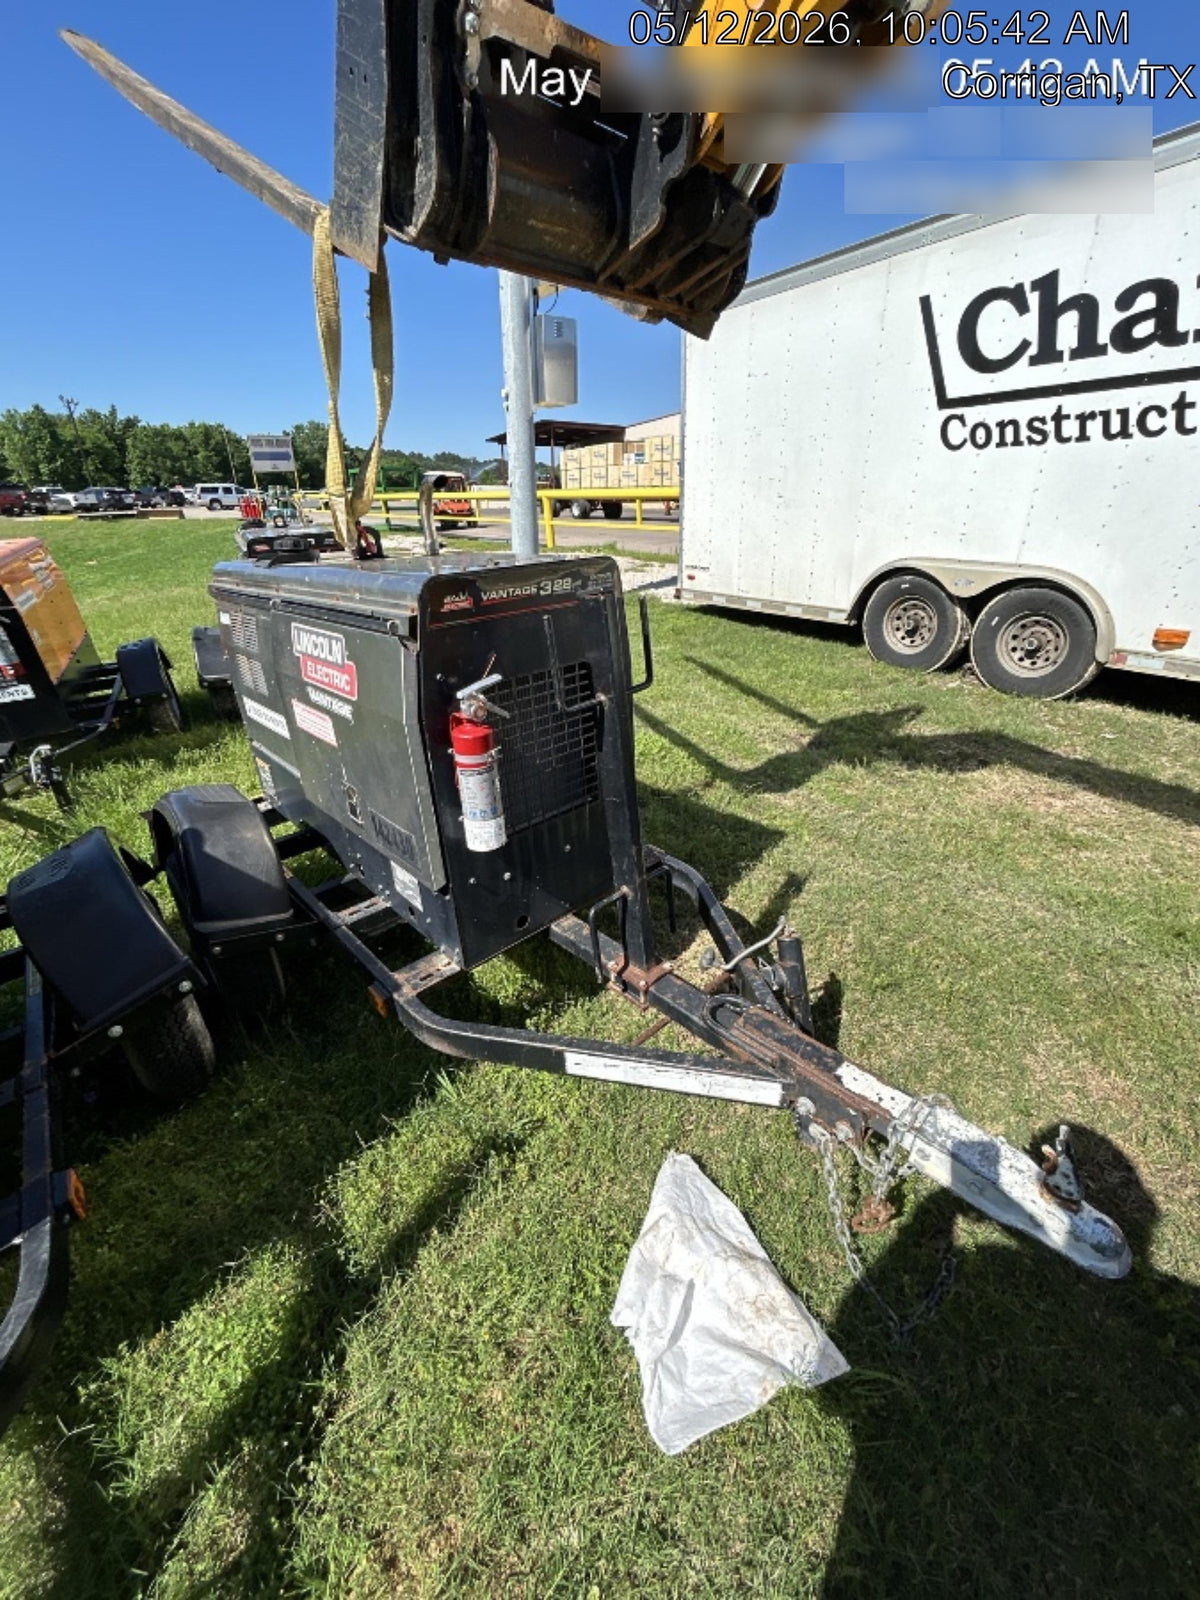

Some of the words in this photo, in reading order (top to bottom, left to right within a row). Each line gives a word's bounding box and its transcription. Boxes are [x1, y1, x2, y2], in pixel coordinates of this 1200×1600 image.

[957, 268, 1200, 374] Cha
[939, 391, 1198, 451] Construct
[293, 629, 344, 666] LINCOLN
[306, 661, 351, 692] ELECTRIC
